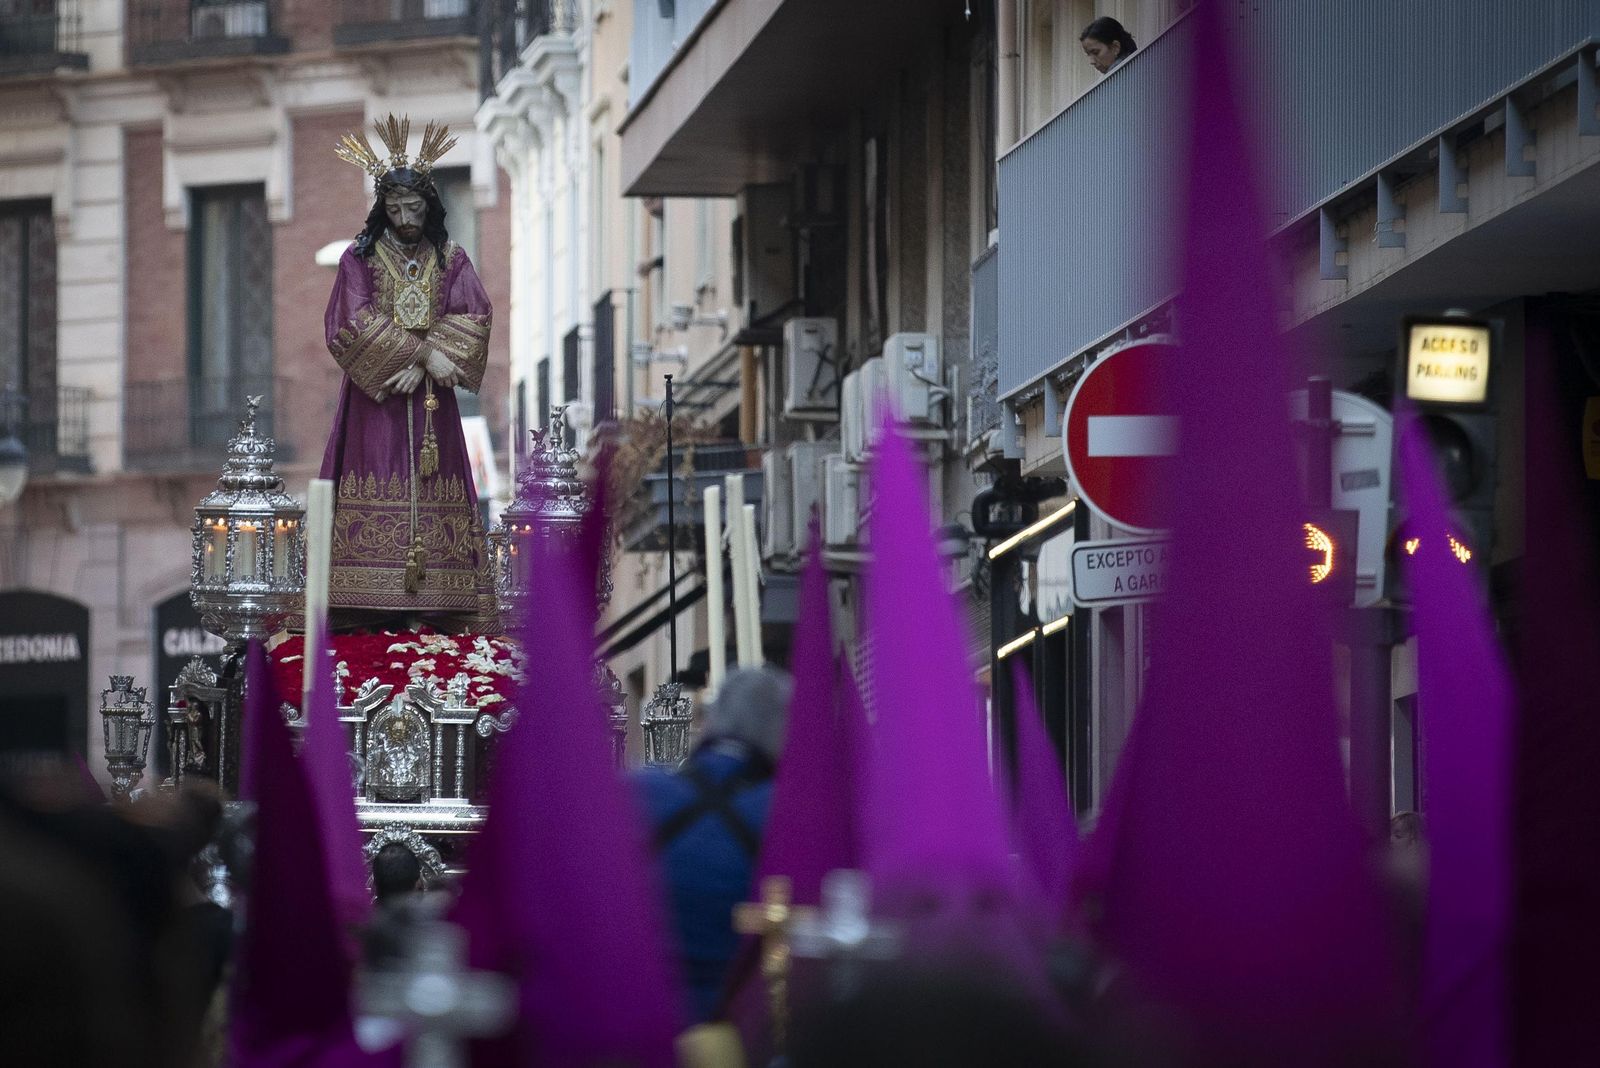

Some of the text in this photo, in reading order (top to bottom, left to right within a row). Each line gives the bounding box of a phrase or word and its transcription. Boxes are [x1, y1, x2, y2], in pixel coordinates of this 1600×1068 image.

[1421, 336, 1479, 354] ACCESO
[1415, 363, 1478, 381] PARING
[1086, 548, 1155, 570] EXCEPTO
[1113, 573, 1163, 593] A GAR
[0, 634, 81, 662] EDONIA
